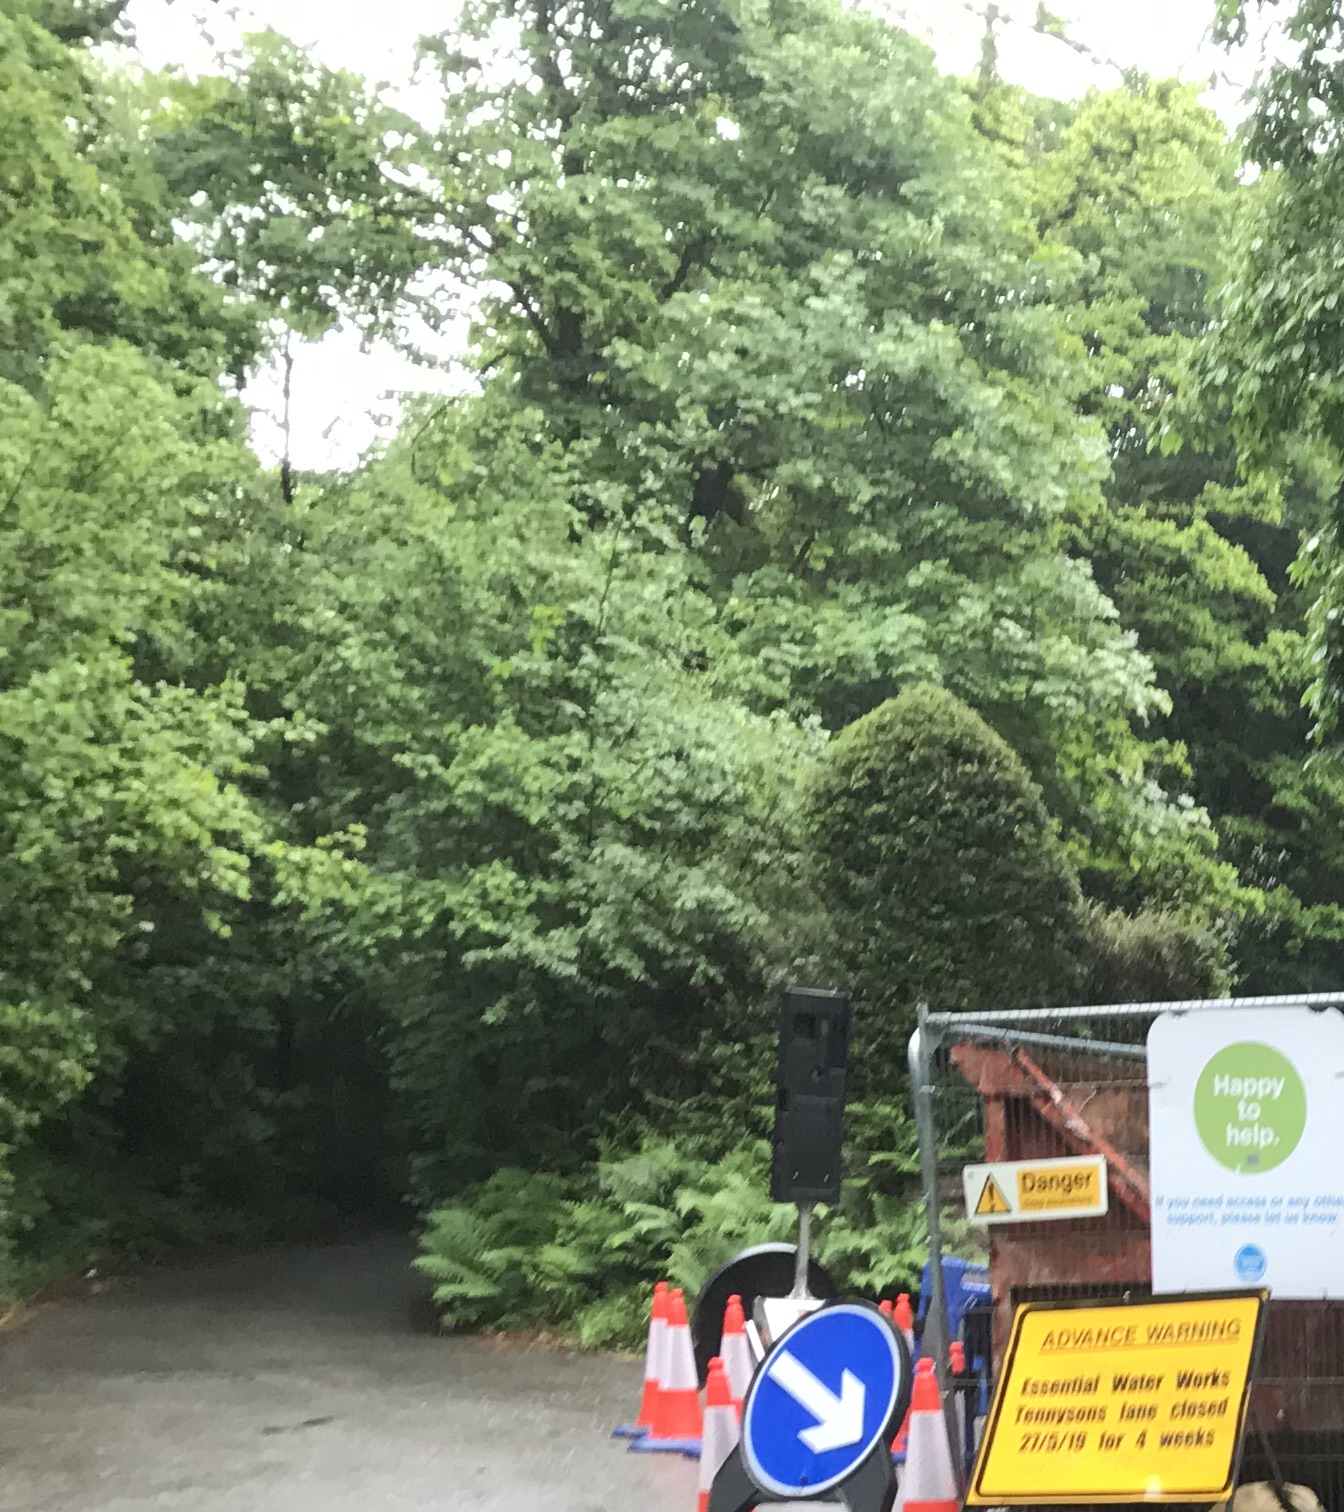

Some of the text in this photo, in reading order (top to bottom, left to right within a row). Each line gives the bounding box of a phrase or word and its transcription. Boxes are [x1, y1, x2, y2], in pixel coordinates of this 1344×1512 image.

[1213, 1073, 1285, 1100] Happy
[1237, 1098, 1261, 1122] to
[1021, 1171, 1093, 1194] Danger
[1167, 1196, 1189, 1210] you
[1192, 1194, 1223, 1207] need
[1042, 1318, 1242, 1349] ADVANCE WARNING
[1021, 1368, 1230, 1397] Essential Water Works
[1014, 1396, 1229, 1426] Tennysons lane closed
[1019, 1427, 1214, 1453] 27/5/19 for 4 weeks
